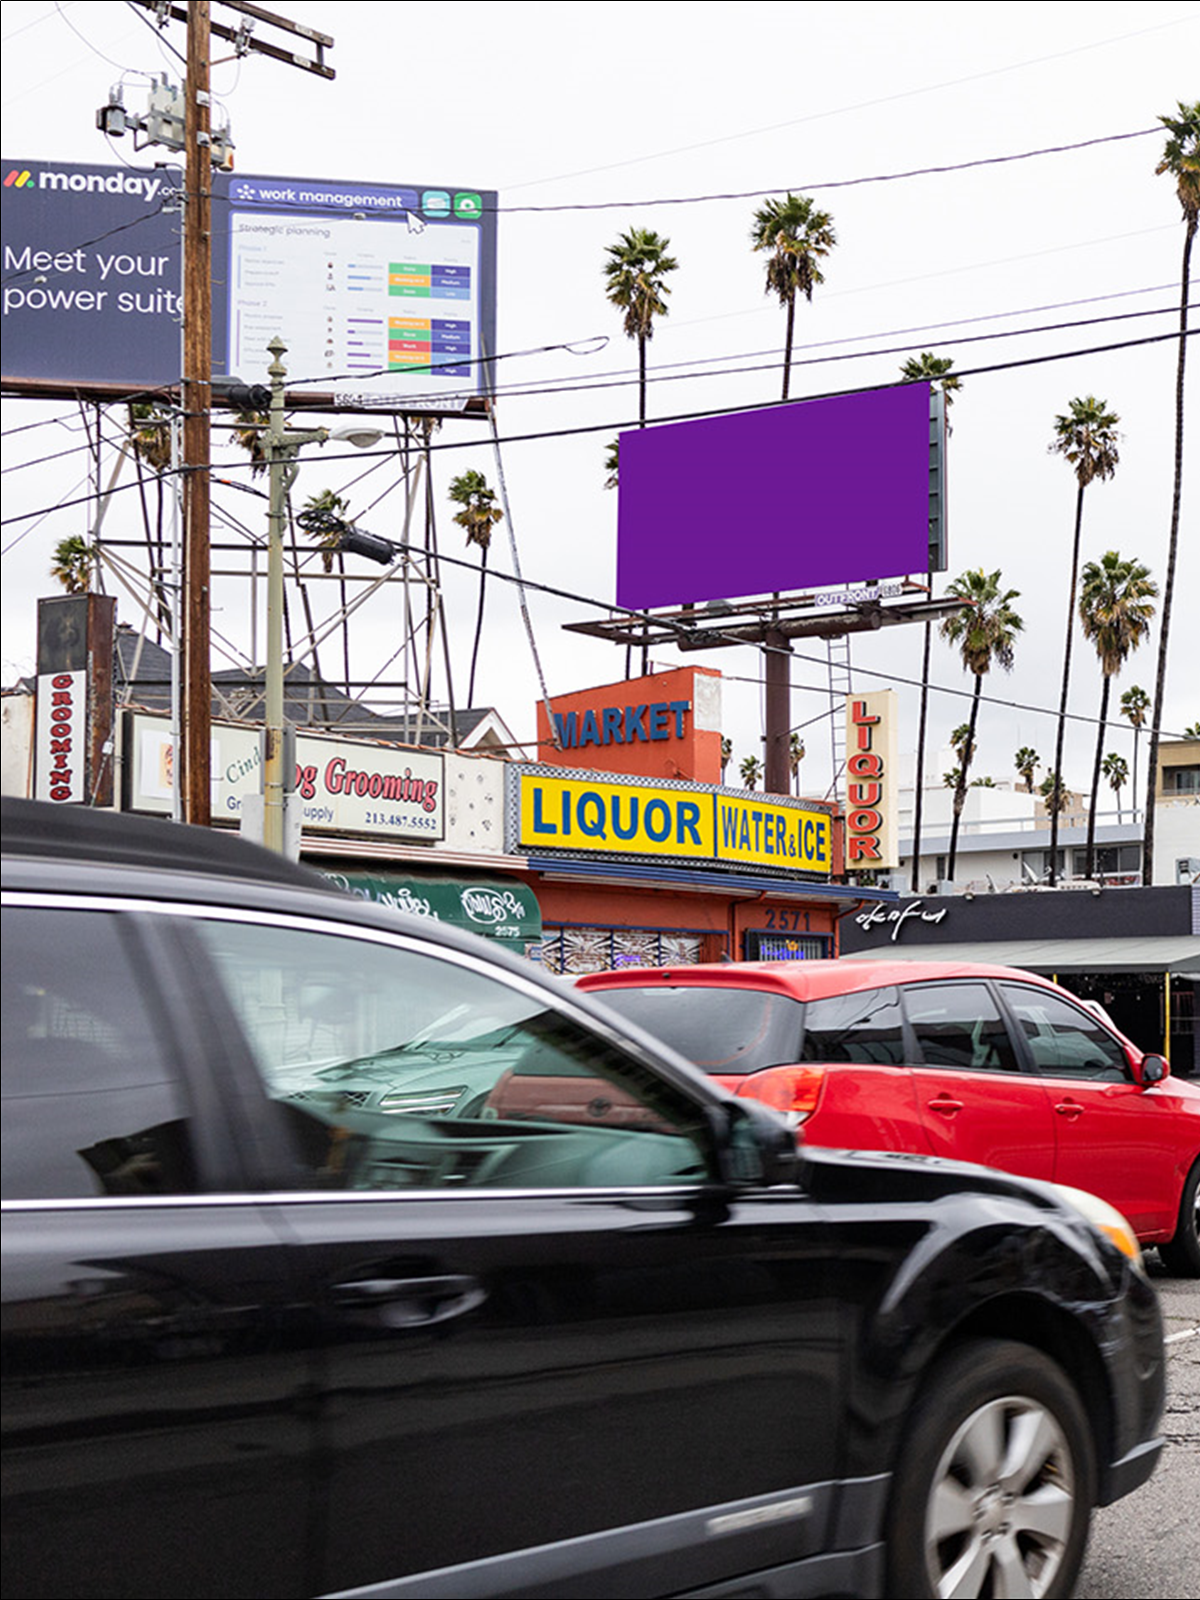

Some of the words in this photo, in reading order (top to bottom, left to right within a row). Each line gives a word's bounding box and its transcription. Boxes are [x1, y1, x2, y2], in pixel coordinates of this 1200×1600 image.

[39, 172, 178, 202] monday.co
[259, 188, 296, 201] work
[299, 191, 403, 208] management
[286, 226, 331, 239] planning
[4, 246, 87, 273] Meet
[96, 253, 170, 281] your
[4, 288, 108, 316] power
[49, 674, 74, 801] GROOMING
[553, 700, 692, 749] MARKET
[225, 746, 261, 784] Cind
[324, 757, 438, 813] Grooming
[847, 700, 884, 862] LIQUOR
[303, 806, 334, 823] upply
[365, 811, 437, 830] 213.487.5552
[533, 787, 702, 846] LIQUOR
[494, 925, 520, 937] 2575
[765, 909, 811, 931] 2571
